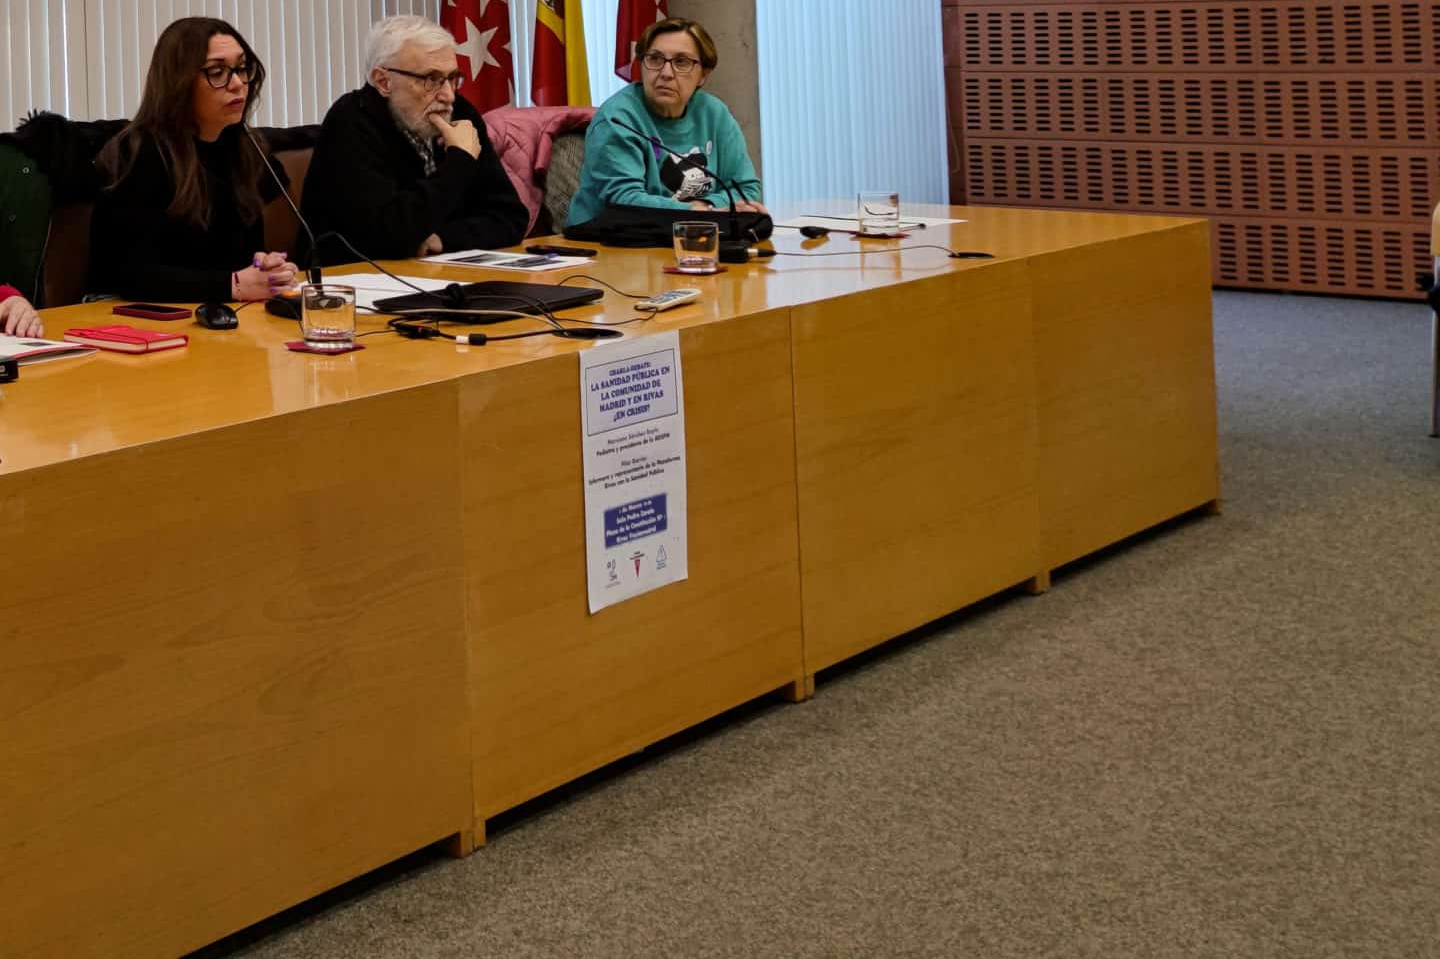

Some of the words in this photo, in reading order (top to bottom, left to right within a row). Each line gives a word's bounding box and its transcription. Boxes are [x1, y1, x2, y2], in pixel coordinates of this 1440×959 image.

[591, 380, 599, 392] LA
[600, 375, 632, 389] SANIDAD
[661, 366, 670, 376] EN
[601, 390, 610, 401] LA
[611, 382, 651, 398] COMUNIDAD
[652, 379, 661, 388] DE
[599, 398, 626, 412] MADRID
[627, 396, 633, 406] Y
[633, 394, 642, 404] EN
[643, 390, 664, 402] RIVAS
